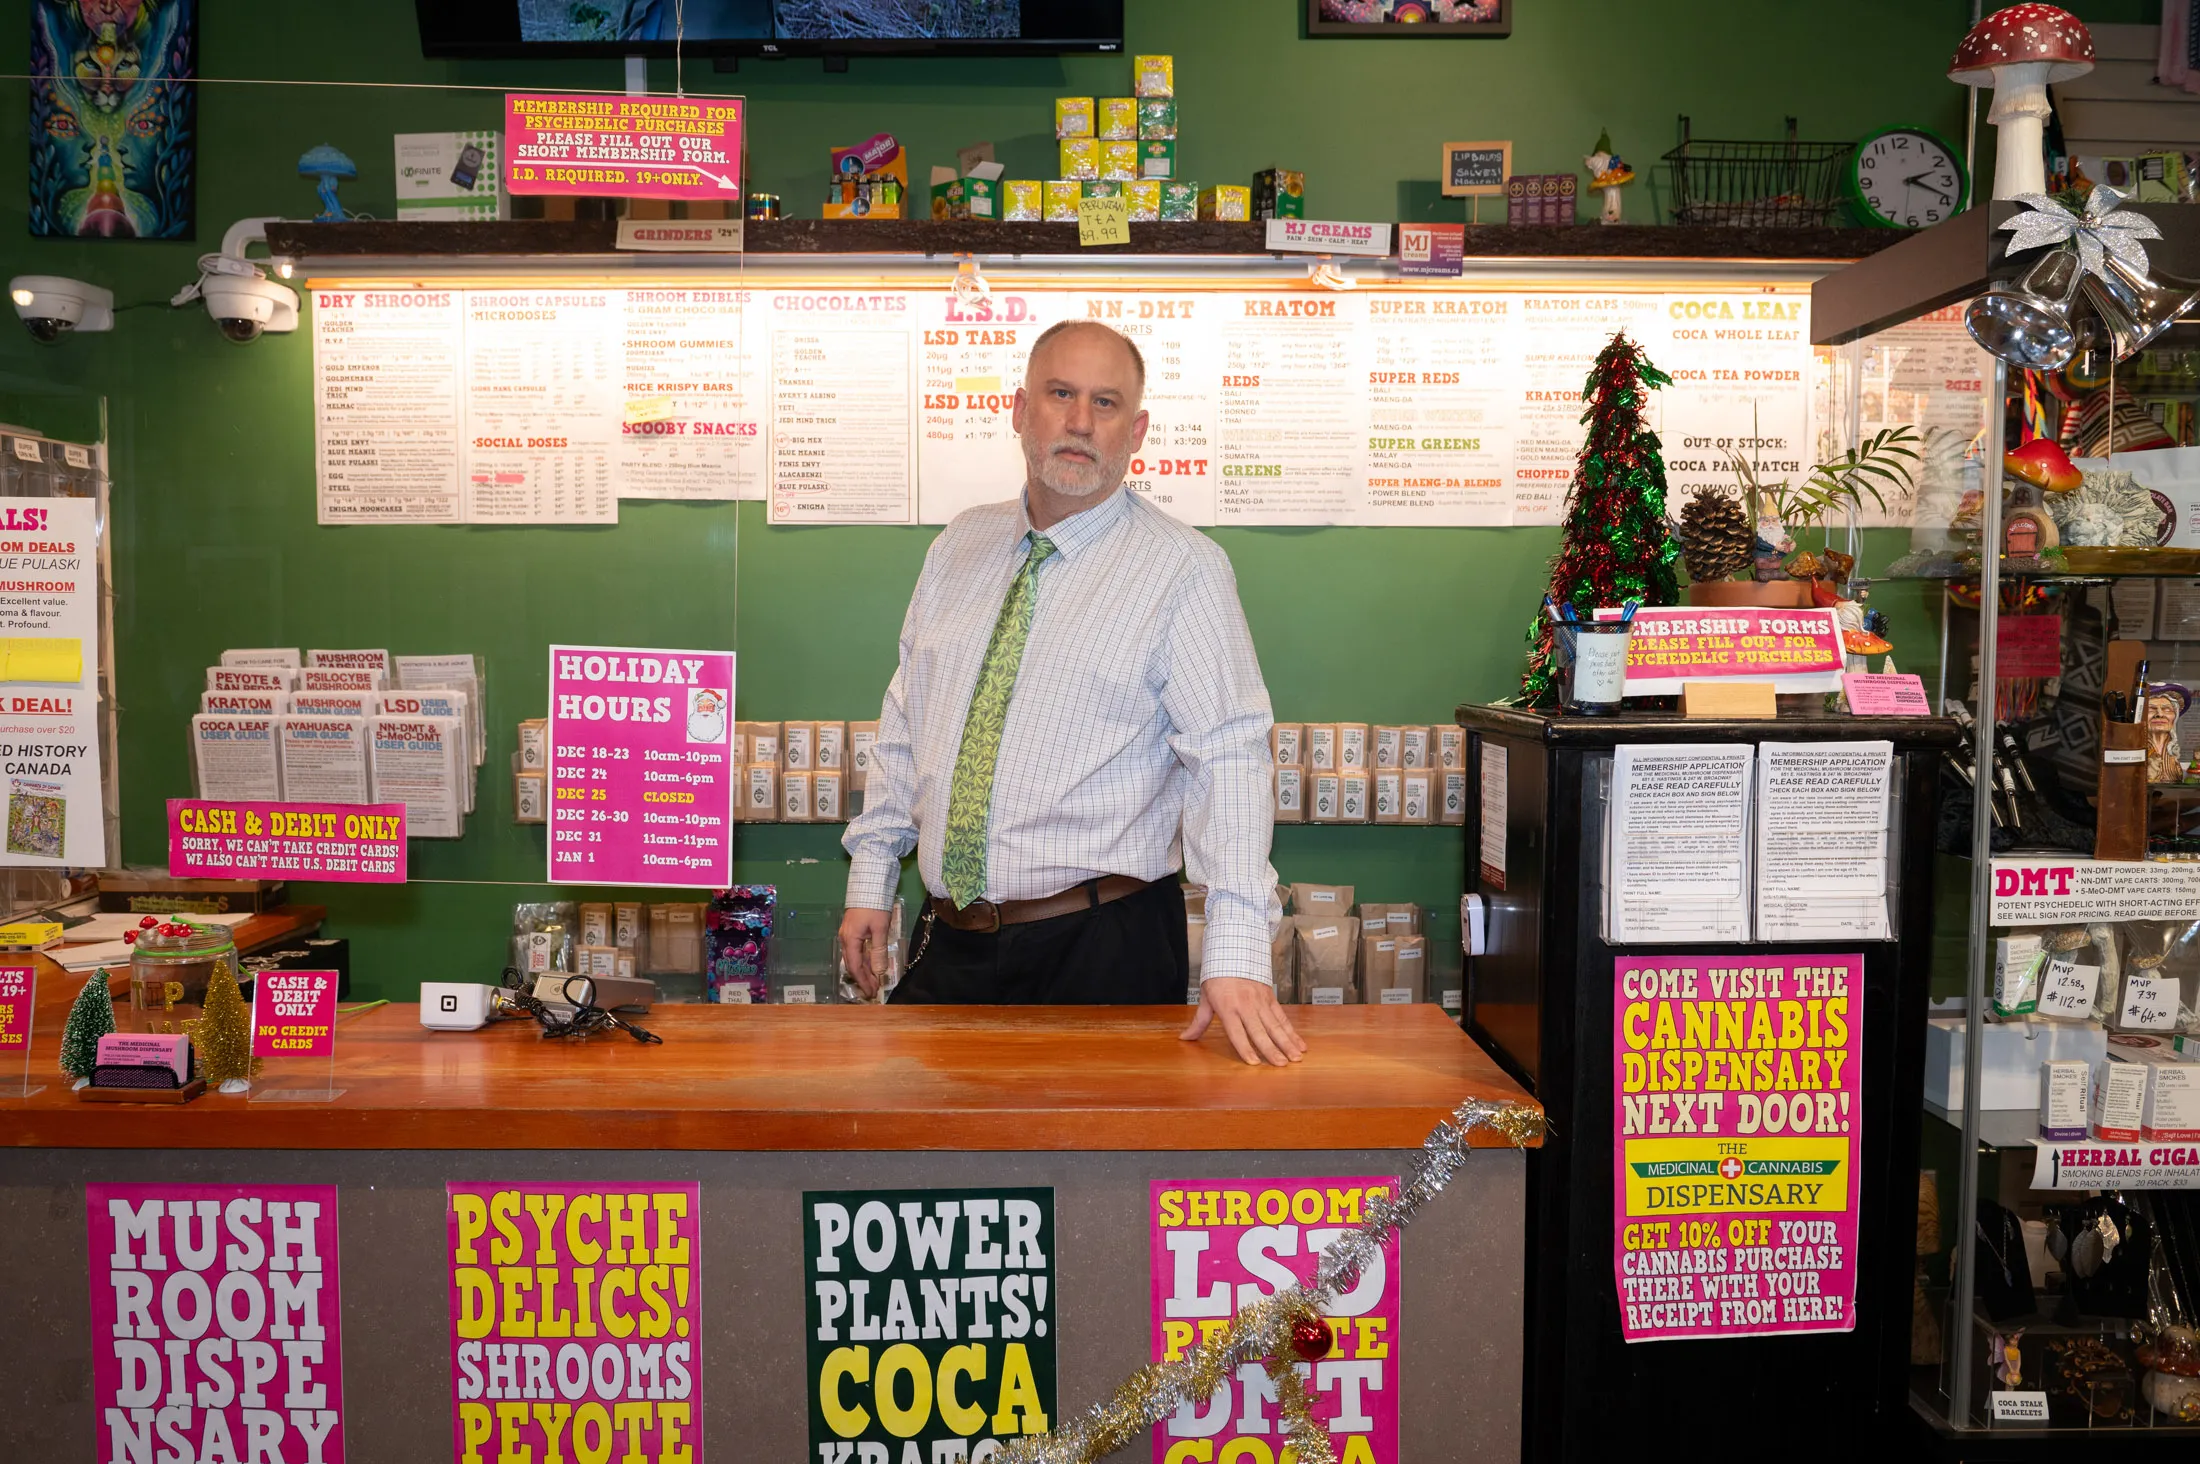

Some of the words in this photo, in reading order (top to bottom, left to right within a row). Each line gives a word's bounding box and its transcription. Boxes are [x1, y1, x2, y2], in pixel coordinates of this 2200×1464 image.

[513, 100, 613, 116] MEMBERSHIP
[619, 103, 700, 119] REQUIRED
[707, 107, 737, 121] FOR
[525, 116, 629, 131] PSYCHEDELIC
[636, 119, 725, 134] PURCHASES
[537, 132, 593, 145] PLEASE
[600, 134, 633, 147] FILL
[639, 136, 672, 149] OUT
[679, 137, 712, 151] OUR
[1892, 137, 1909, 150] 12
[518, 144, 569, 158] SHORT
[576, 146, 676, 162] MEMBERSHIP
[683, 150, 730, 164] FORM.
[512, 167, 538, 180] I.D.
[545, 168, 629, 185] REQUIRED.
[636, 171, 703, 186] 19+ONLY.
[1080, 200, 1125, 212] PERUVIAN
[634, 229, 712, 241] GRINDERS
[1080, 227, 1118, 241] $9.99
[1285, 222, 1306, 234] MJ
[1311, 224, 1372, 238] CREAMS
[320, 294, 355, 308] DRY
[364, 293, 451, 308] SHROOMS
[773, 296, 907, 311] CHOCOLATES
[1244, 300, 1336, 316] KRATOM
[1669, 302, 1734, 320] COCA
[1742, 302, 1802, 320] LEAF
[924, 330, 959, 345] LSD
[966, 330, 1016, 345] TABS
[1222, 376, 1260, 387] REDS
[1672, 370, 1708, 381] COCA
[1713, 370, 1739, 381] TEA
[1744, 370, 1800, 381] POWDER
[627, 383, 653, 392] RICE
[657, 383, 699, 392] KRISPY
[703, 383, 733, 392] BARS
[622, 421, 686, 436] SCOOBY
[693, 422, 757, 436] SNACKS
[476, 437, 523, 448] SOCIAL
[527, 437, 568, 448] DOSES
[1369, 438, 1416, 449] SUPER
[1421, 438, 1481, 449] GREENS
[1683, 437, 1710, 449] OUT
[1715, 437, 1733, 449] OF
[1737, 437, 1787, 449] STOCK:
[1222, 465, 1283, 476] GREENS
[28, 542, 75, 553] DEALS
[22, 558, 80, 570] PULASKI
[1628, 619, 1749, 636] EMBERSHIP
[1758, 618, 1830, 635] FORMS
[1629, 637, 1690, 651] PLEASE
[1697, 636, 1734, 650] FILL
[1740, 636, 1776, 650] OUT
[1783, 636, 1817, 649] FOR
[1626, 649, 1729, 666] SYCHEDELIC
[1736, 649, 1833, 664] PURCHASES
[559, 655, 704, 685] HOLIDAY
[384, 699, 419, 713] LSD
[558, 694, 671, 723] HOURS
[200, 721, 237, 731] COCA
[240, 721, 269, 731] LEAF
[285, 721, 353, 732] AYAHUASCA
[200, 731, 230, 740] USER
[232, 731, 270, 740] GUIDE
[292, 731, 316, 740] USER
[318, 731, 350, 740] GUIDE
[18, 745, 87, 758] HISTORY
[557, 746, 585, 758] DEC
[592, 747, 629, 760] 18-23
[644, 749, 722, 765] 10am-10pm
[5, 762, 72, 776] CANADA
[1770, 758, 1830, 766] MEMBERSHIP
[1833, 758, 1886, 766] APPLICATION
[557, 767, 585, 779] DEC
[591, 768, 607, 780] 24
[644, 771, 714, 786] 10am-6pm
[557, 788, 585, 800] DEC
[591, 789, 607, 801] 25
[643, 792, 694, 804] CLOSED
[180, 808, 237, 835] CASH
[244, 810, 263, 836] &
[269, 812, 337, 838] DEBIT
[344, 815, 401, 840] ONLY
[182, 836, 223, 854] SORRY,
[225, 838, 244, 852] WE
[246, 839, 281, 853] CAN'T
[283, 841, 312, 855] TAKE
[316, 842, 358, 857] CREDIT
[360, 844, 399, 858] CARDS!
[556, 851, 582, 863] JAN
[588, 851, 595, 863] 1
[642, 854, 712, 869] 10am-6pm
[1995, 867, 2074, 897] DMT
[2080, 886, 2125, 895] 5-MeO-DMT
[2127, 886, 2144, 895] VAPE
[2145, 886, 2173, 894] CARTS:
[2175, 886, 2197, 895] 150mg
[2079, 911, 2112, 919] PRICING.
[2137, 910, 2163, 918] GUIDE
[2164, 910, 2197, 918] BEFORE
[2051, 963, 2073, 974] MVP
[1622, 968, 1698, 1000] COME
[1708, 967, 1784, 999] VISIT
[1793, 966, 1849, 998] THE
[1622, 996, 1849, 1050] CANNABIS
[1622, 1049, 1848, 1093] DISPENSARY
[1622, 1092, 1724, 1135] NEXT
[1736, 1091, 1850, 1134] DOOR!
[1718, 1143, 1747, 1155] THE
[2060, 1148, 2142, 1167] HERBAL
[1647, 1162, 1715, 1176] MEDICINAL
[1748, 1161, 1823, 1174] CANNABIS
[2061, 1168, 2104, 1178] SMOKING
[2105, 1168, 2143, 1178] BLENDS
[2144, 1168, 2163, 1178] FOR
[1646, 1183, 1824, 1209] DISPENSARY
[108, 1197, 323, 1272] MUSH
[452, 1190, 691, 1265] PSYCHE
[814, 1198, 1047, 1273] POWER
[1622, 1221, 1671, 1250] GET
[1678, 1220, 1721, 1249] 10%
[1727, 1219, 1772, 1247] OFF
[1778, 1220, 1838, 1245] YOUR
[1164, 1224, 1386, 1318] LSD
[110, 1270, 326, 1341] ROOM
[454, 1264, 690, 1339] DELICS!
[815, 1273, 1048, 1341] PLANTS!
[1626, 1301, 1714, 1330] RECEIPT
[1719, 1299, 1777, 1326] FROM
[1783, 1296, 1844, 1321] HERE!
[113, 1337, 327, 1409] DISPE
[457, 1340, 692, 1400] SHROOMS
[820, 1342, 1048, 1438] COCA
[2001, 1408, 2043, 1417] BRACELETS
[104, 1404, 339, 1464] NSARY
[459, 1401, 693, 1464] PEYOTE
